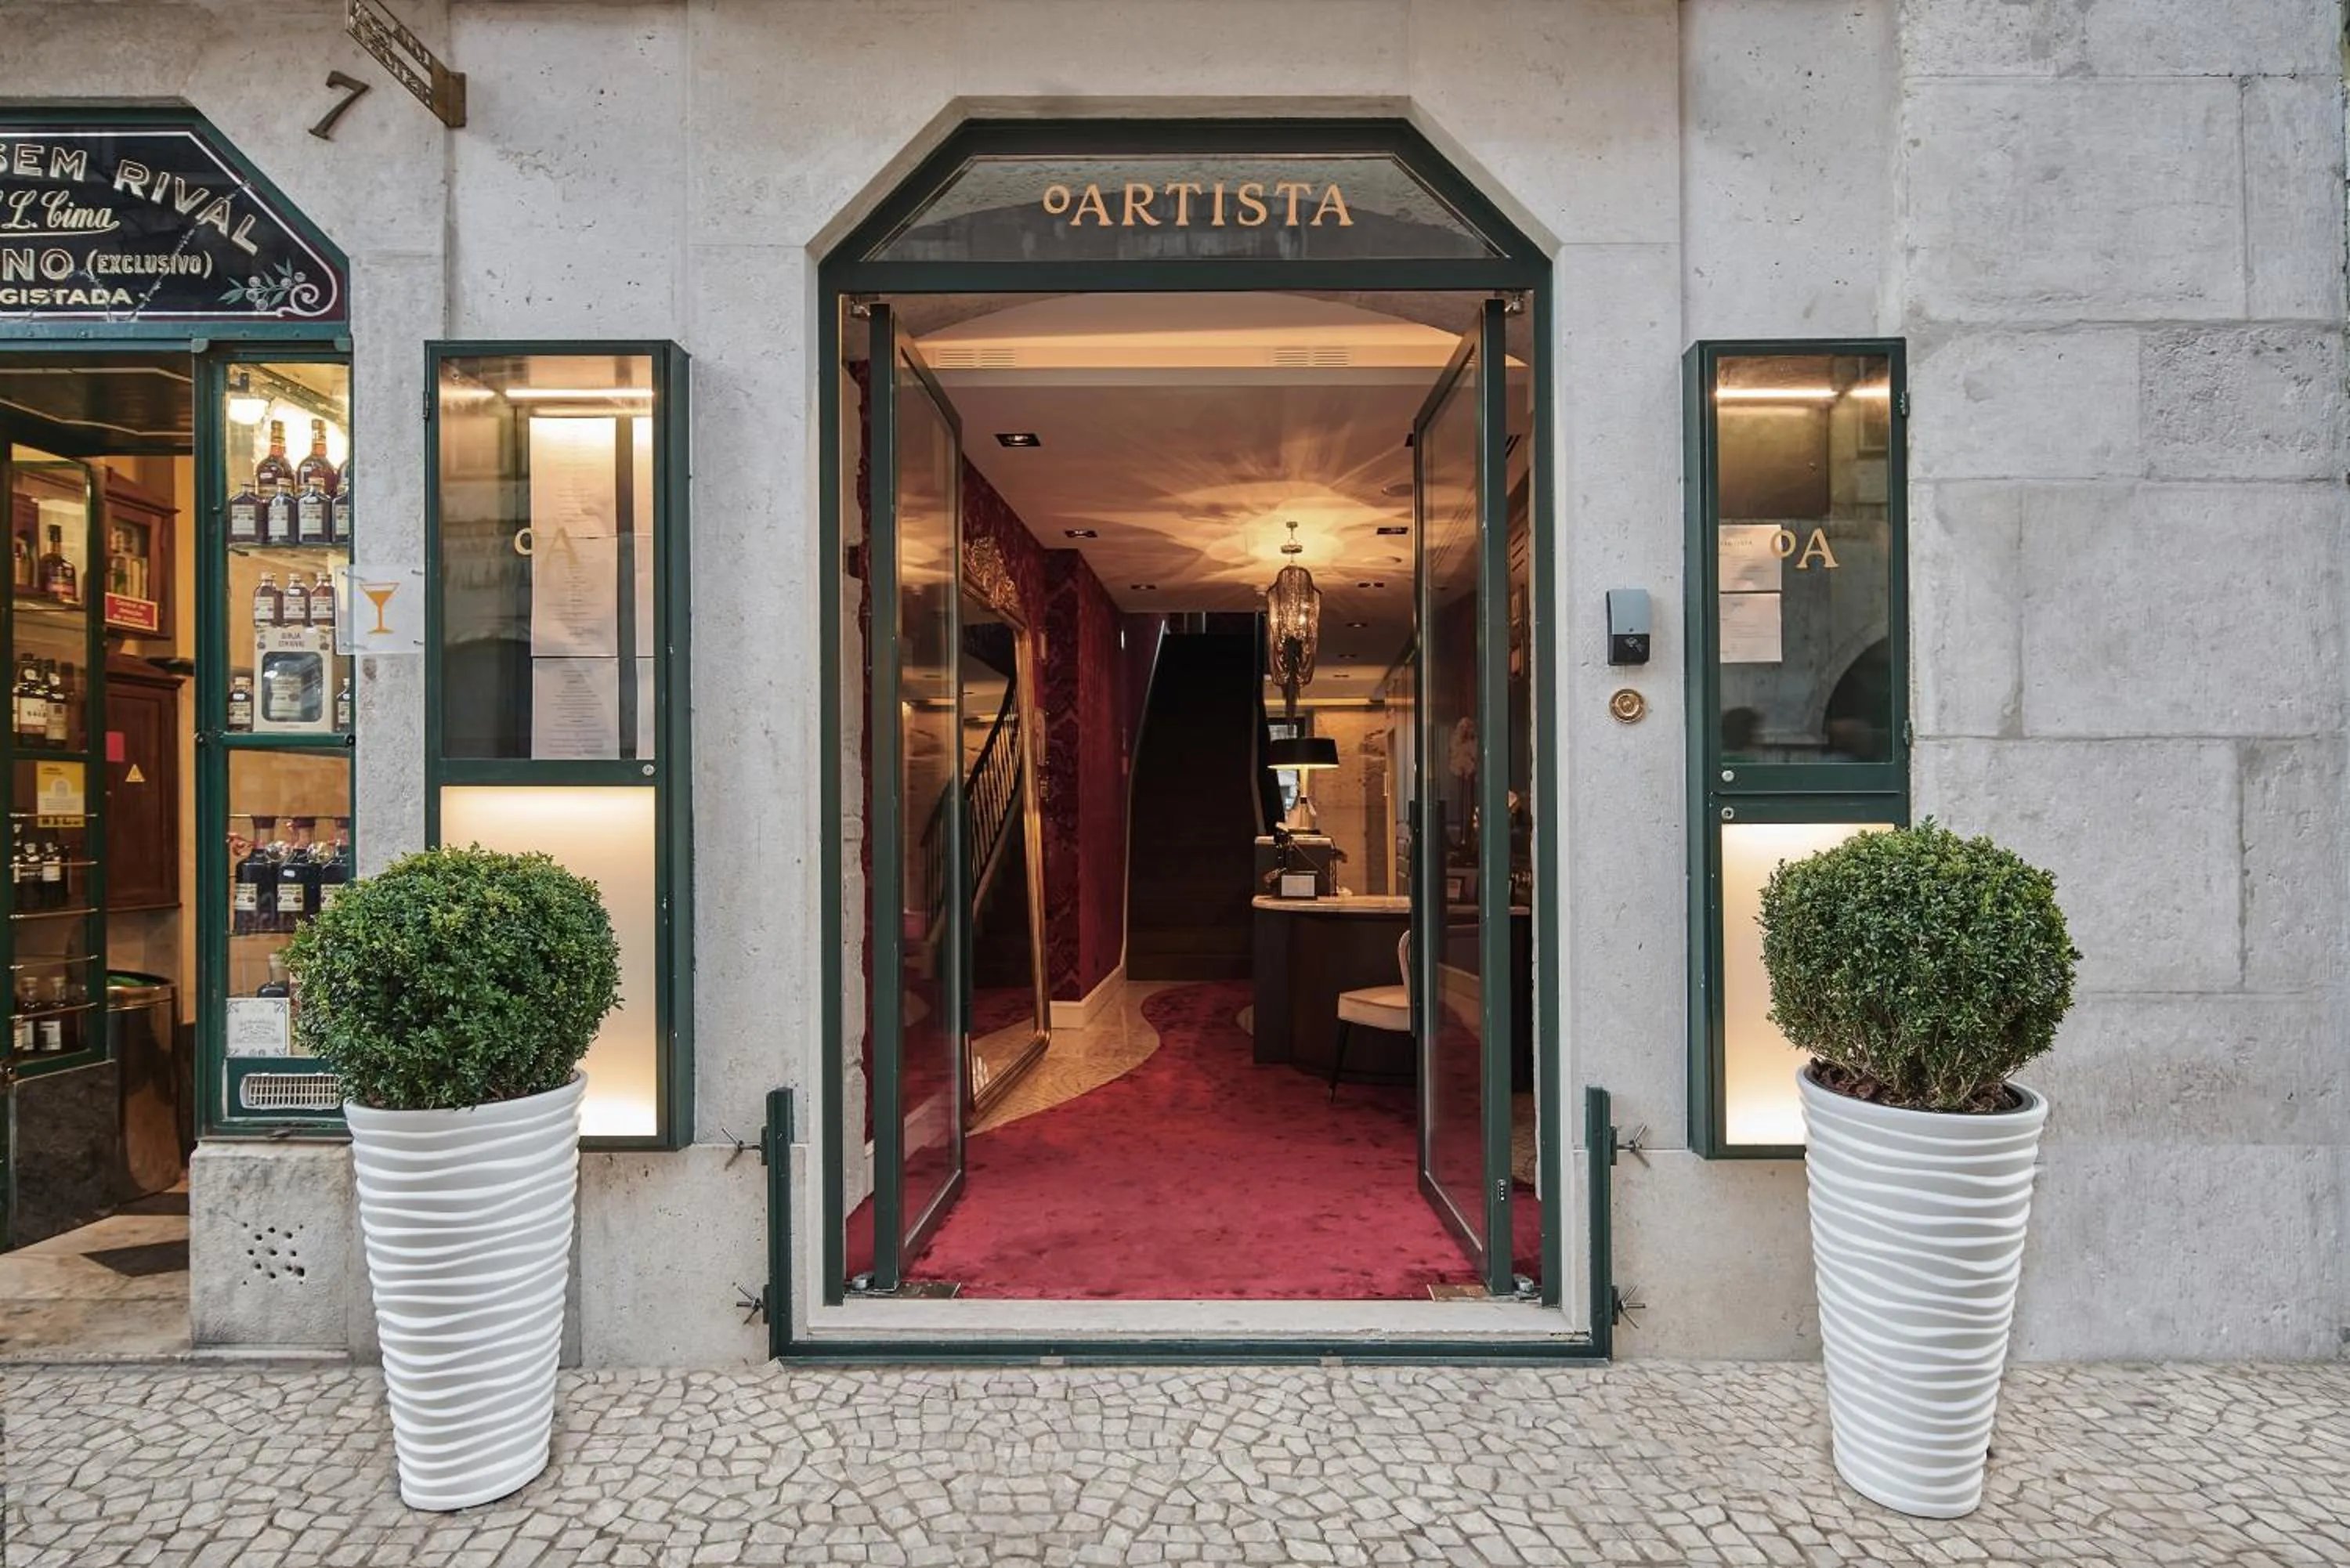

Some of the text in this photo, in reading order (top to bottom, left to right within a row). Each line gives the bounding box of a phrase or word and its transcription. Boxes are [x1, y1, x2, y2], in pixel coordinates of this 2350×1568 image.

[308, 70, 370, 140] 7
[41, 190, 120, 229] Cima
[113, 159, 258, 256] RIVAL
[2, 248, 212, 281] NO (EXCLUSIVO)
[0, 288, 133, 305] GISTADA
